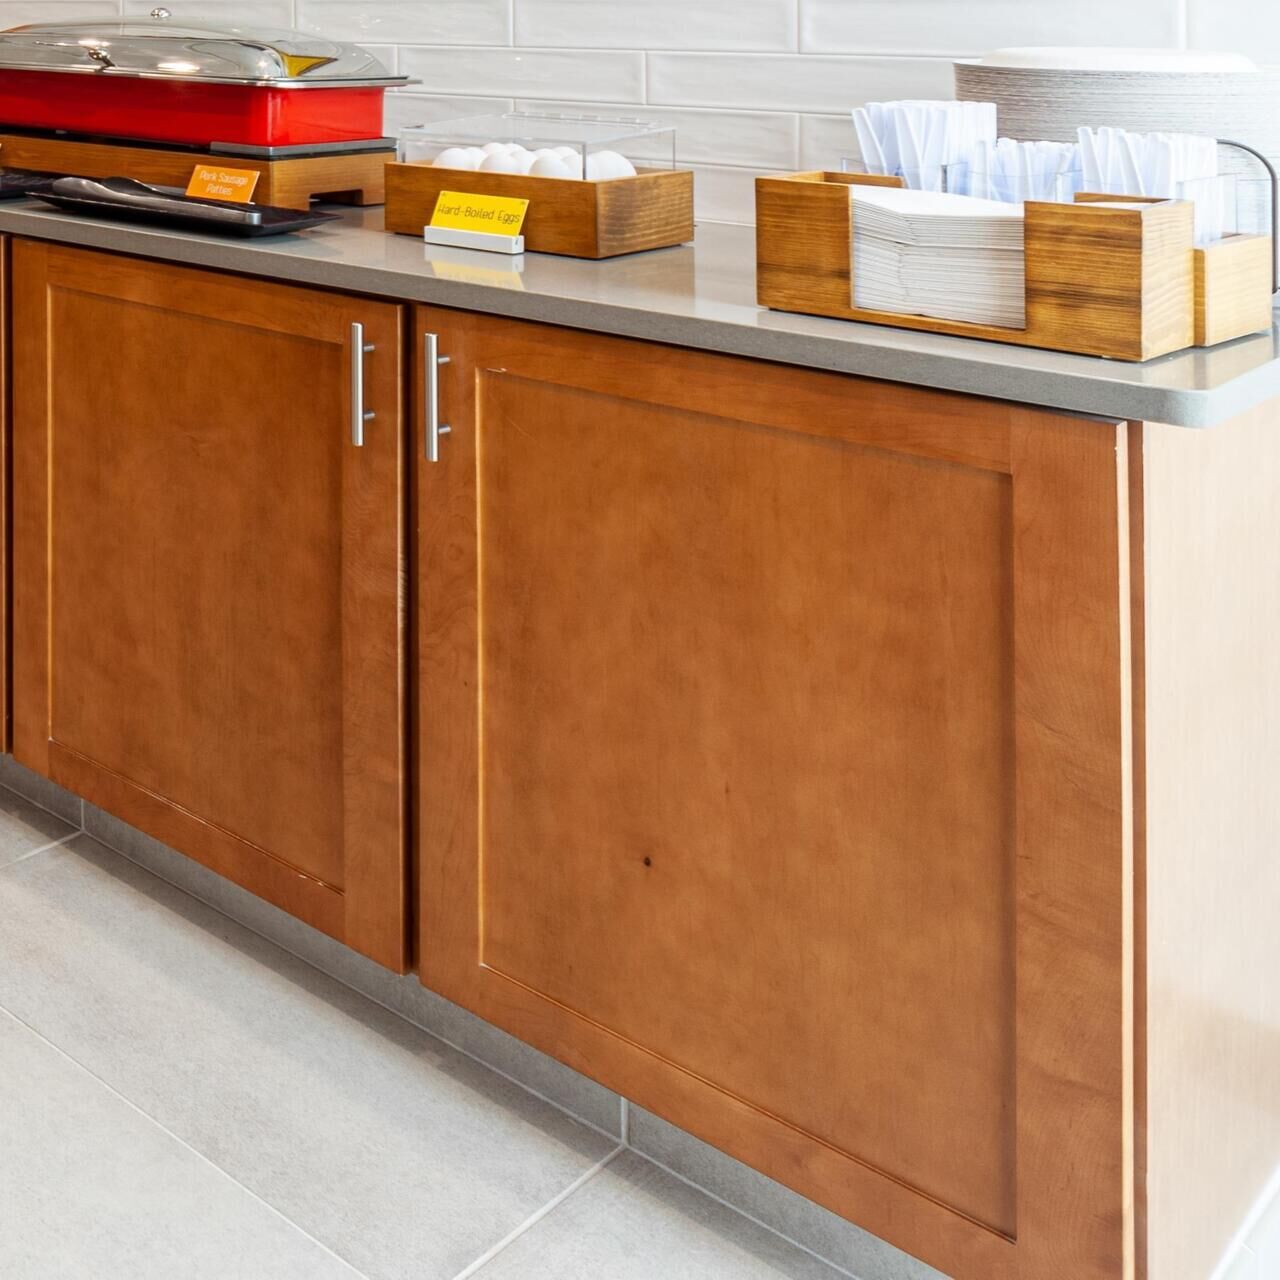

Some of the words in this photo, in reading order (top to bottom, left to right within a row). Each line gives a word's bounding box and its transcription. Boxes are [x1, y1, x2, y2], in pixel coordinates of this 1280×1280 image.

[199, 169, 217, 181] Pork
[218, 172, 249, 187] Sausage
[206, 183, 233, 196] Patties
[437, 204, 495, 220] Hard-Boiled
[498, 210, 521, 225] Eggs
